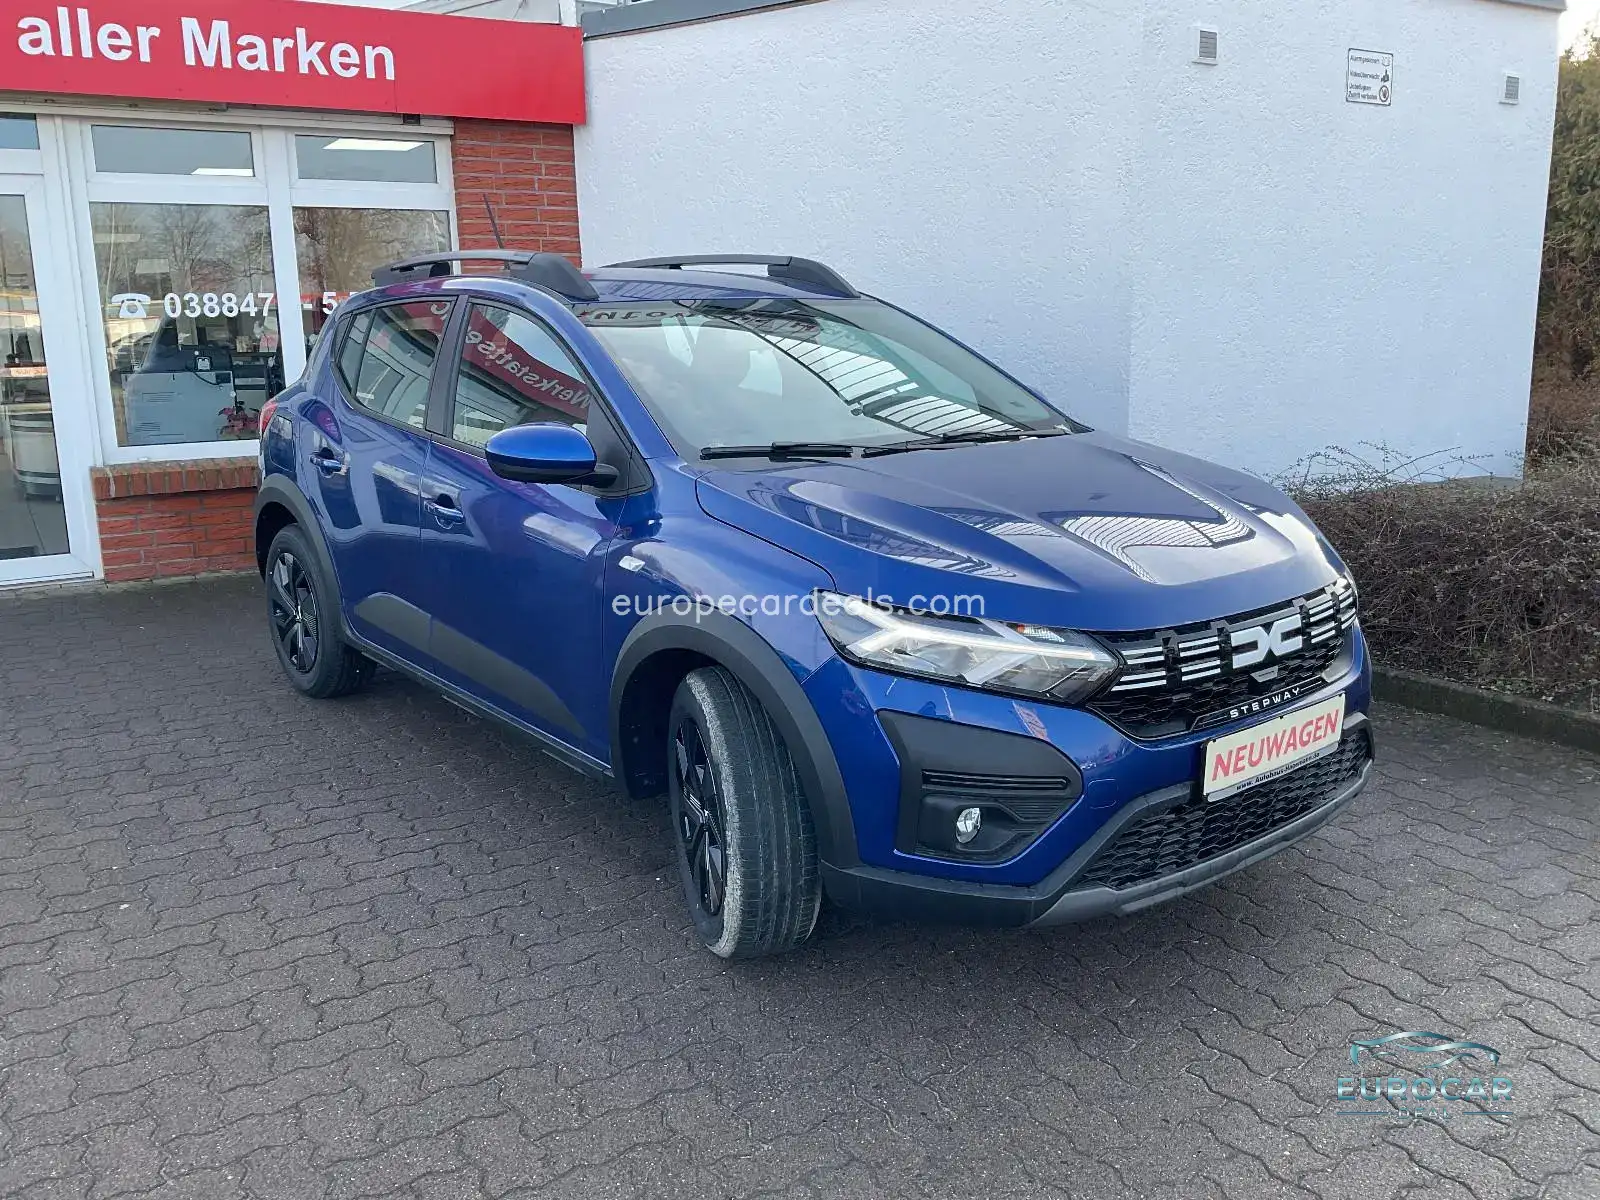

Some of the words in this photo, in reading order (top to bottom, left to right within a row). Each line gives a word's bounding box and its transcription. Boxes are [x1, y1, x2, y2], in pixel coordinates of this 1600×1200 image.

[17, 6, 160, 63] aller
[181, 16, 396, 81] Marken
[164, 292, 274, 318] 038847
[1229, 687, 1301, 718] STEPWAY
[1211, 709, 1339, 782] NEUWAGEN
